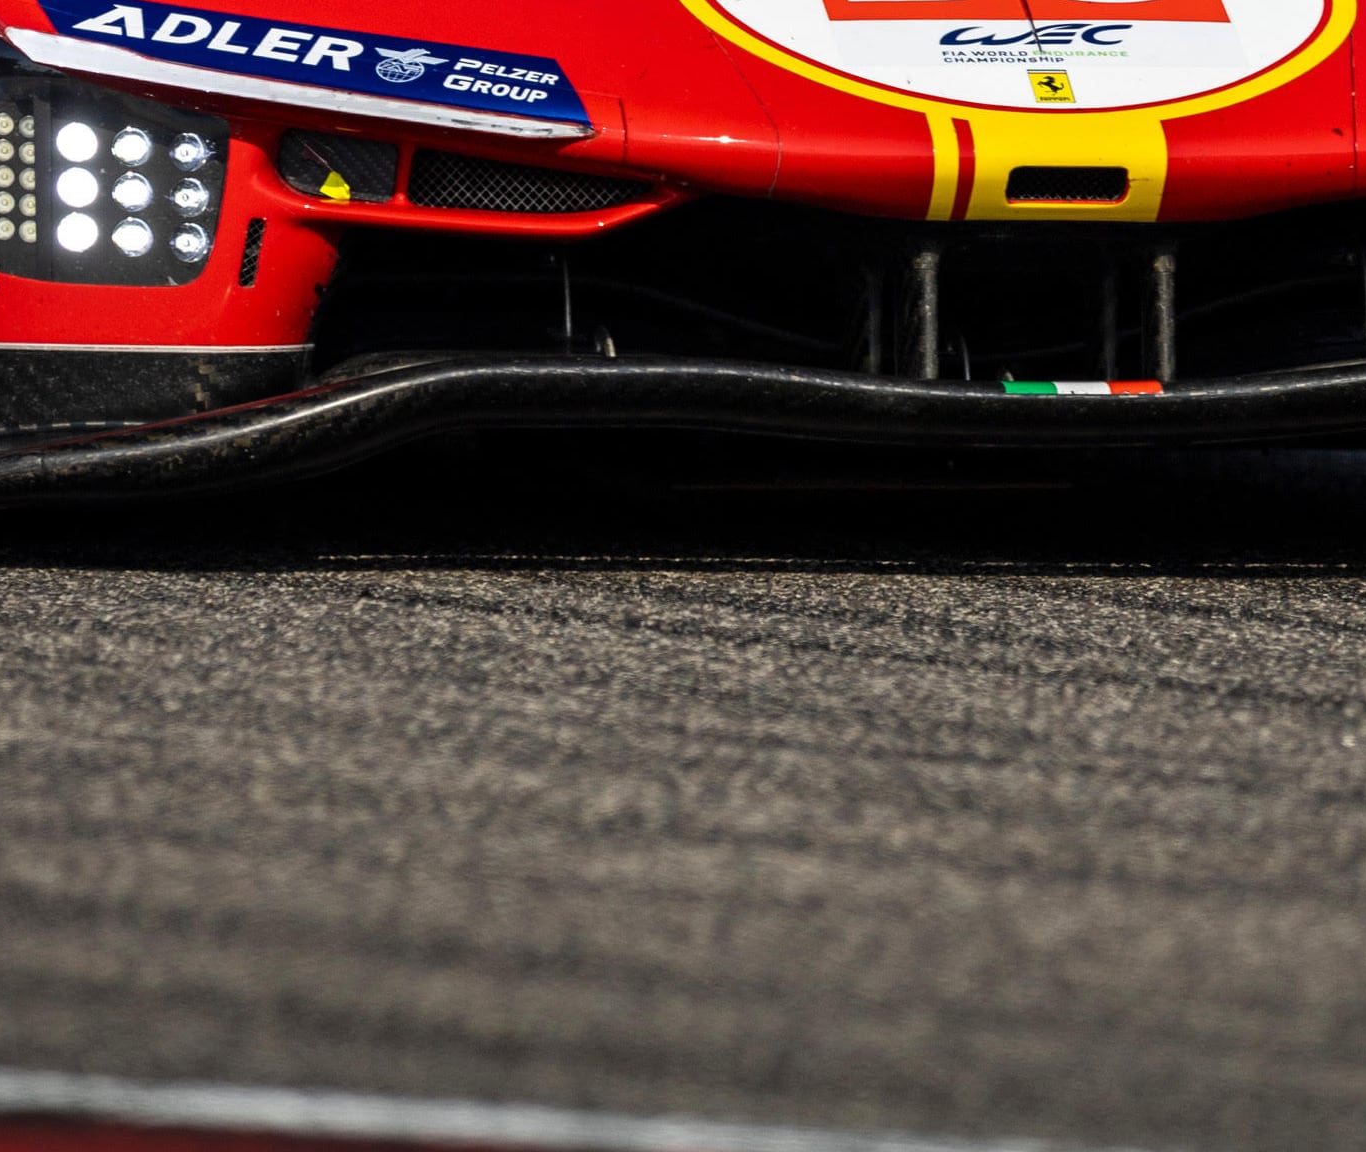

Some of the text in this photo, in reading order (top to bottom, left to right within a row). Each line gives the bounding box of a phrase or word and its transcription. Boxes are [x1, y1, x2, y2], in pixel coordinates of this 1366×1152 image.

[72, 3, 560, 87] ADLER PELZER
[939, 23, 1134, 46] WEC
[943, 56, 1065, 64] CHAMPIONSHIP
[442, 73, 549, 105] GROUP
